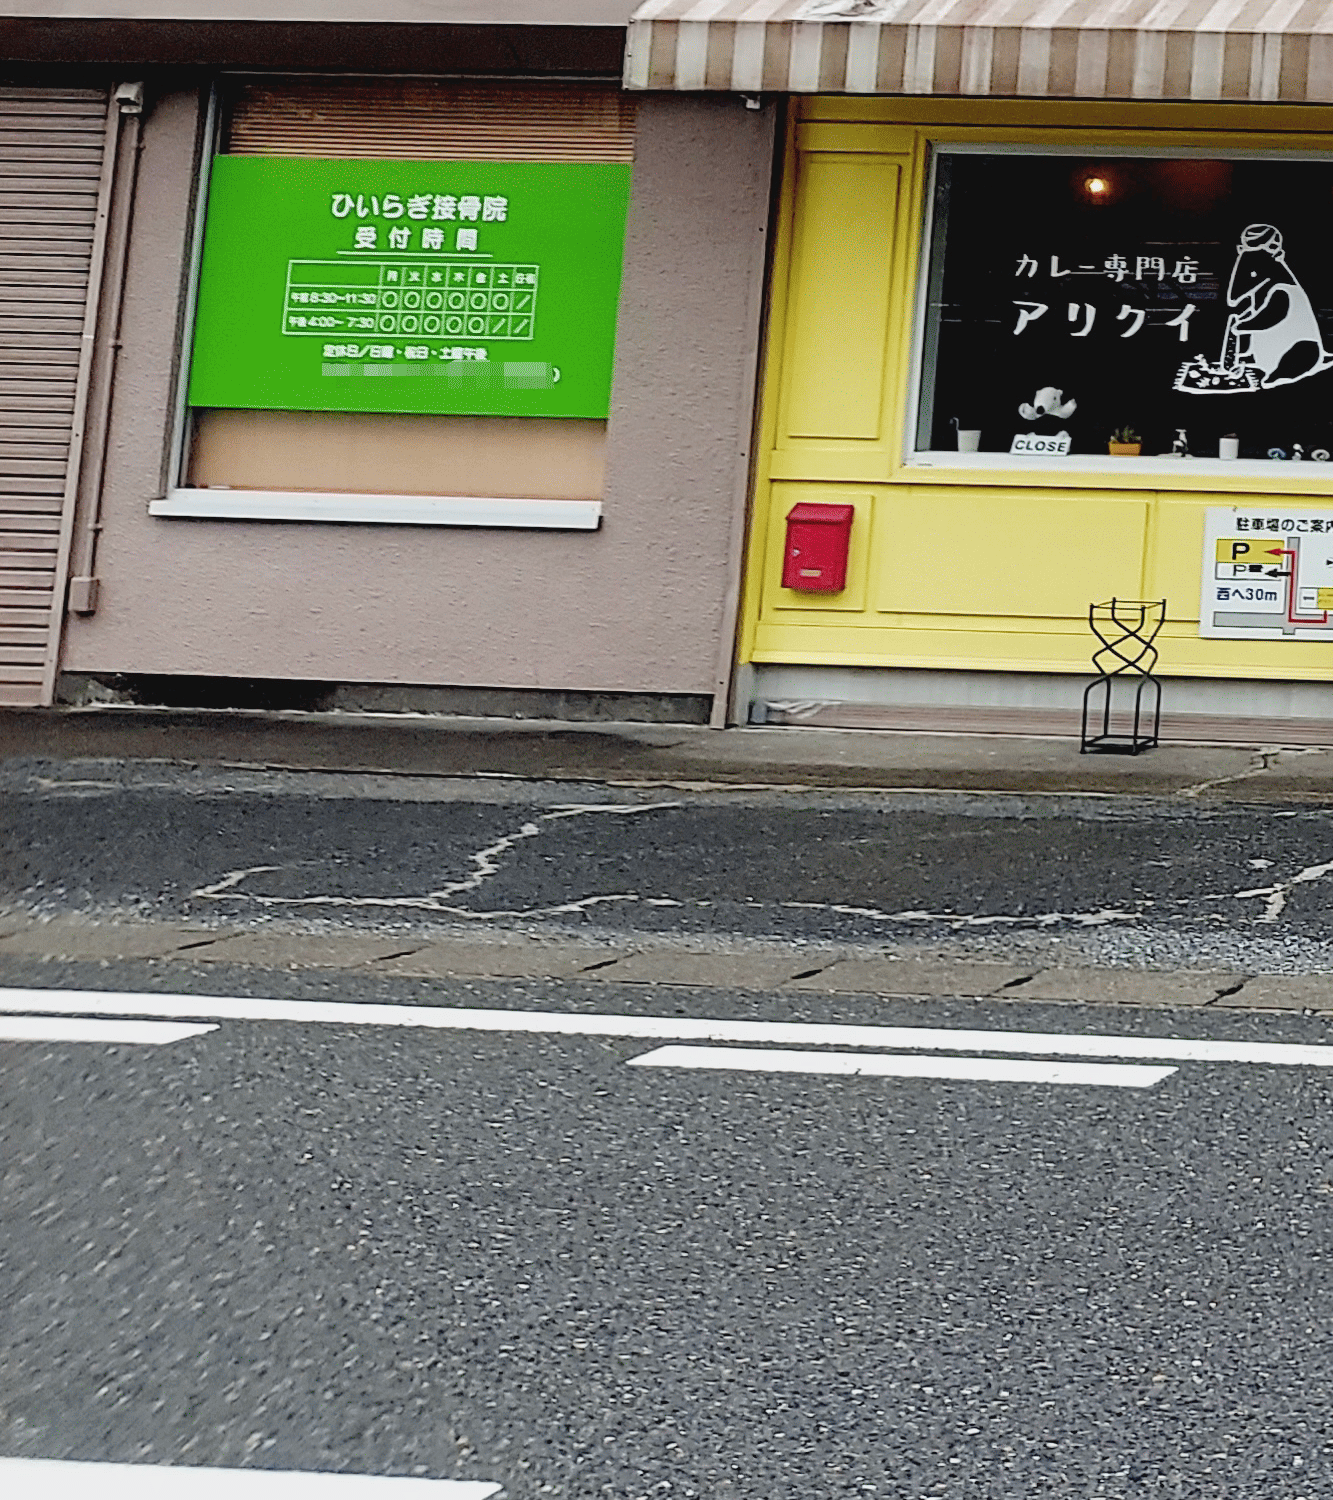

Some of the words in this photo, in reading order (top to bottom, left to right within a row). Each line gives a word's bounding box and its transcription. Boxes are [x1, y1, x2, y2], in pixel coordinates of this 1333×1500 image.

[331, 193, 508, 222] ひいらぎ接骨院
[353, 226, 479, 251] 受付時間
[1015, 253, 1199, 283] カレー専門店
[1012, 300, 1196, 342] アリクイ
[1015, 440, 1067, 452] CLOSE
[1231, 542, 1251, 561] P
[1232, 564, 1247, 577] P
[1216, 586, 1278, 602] 西へ30m
